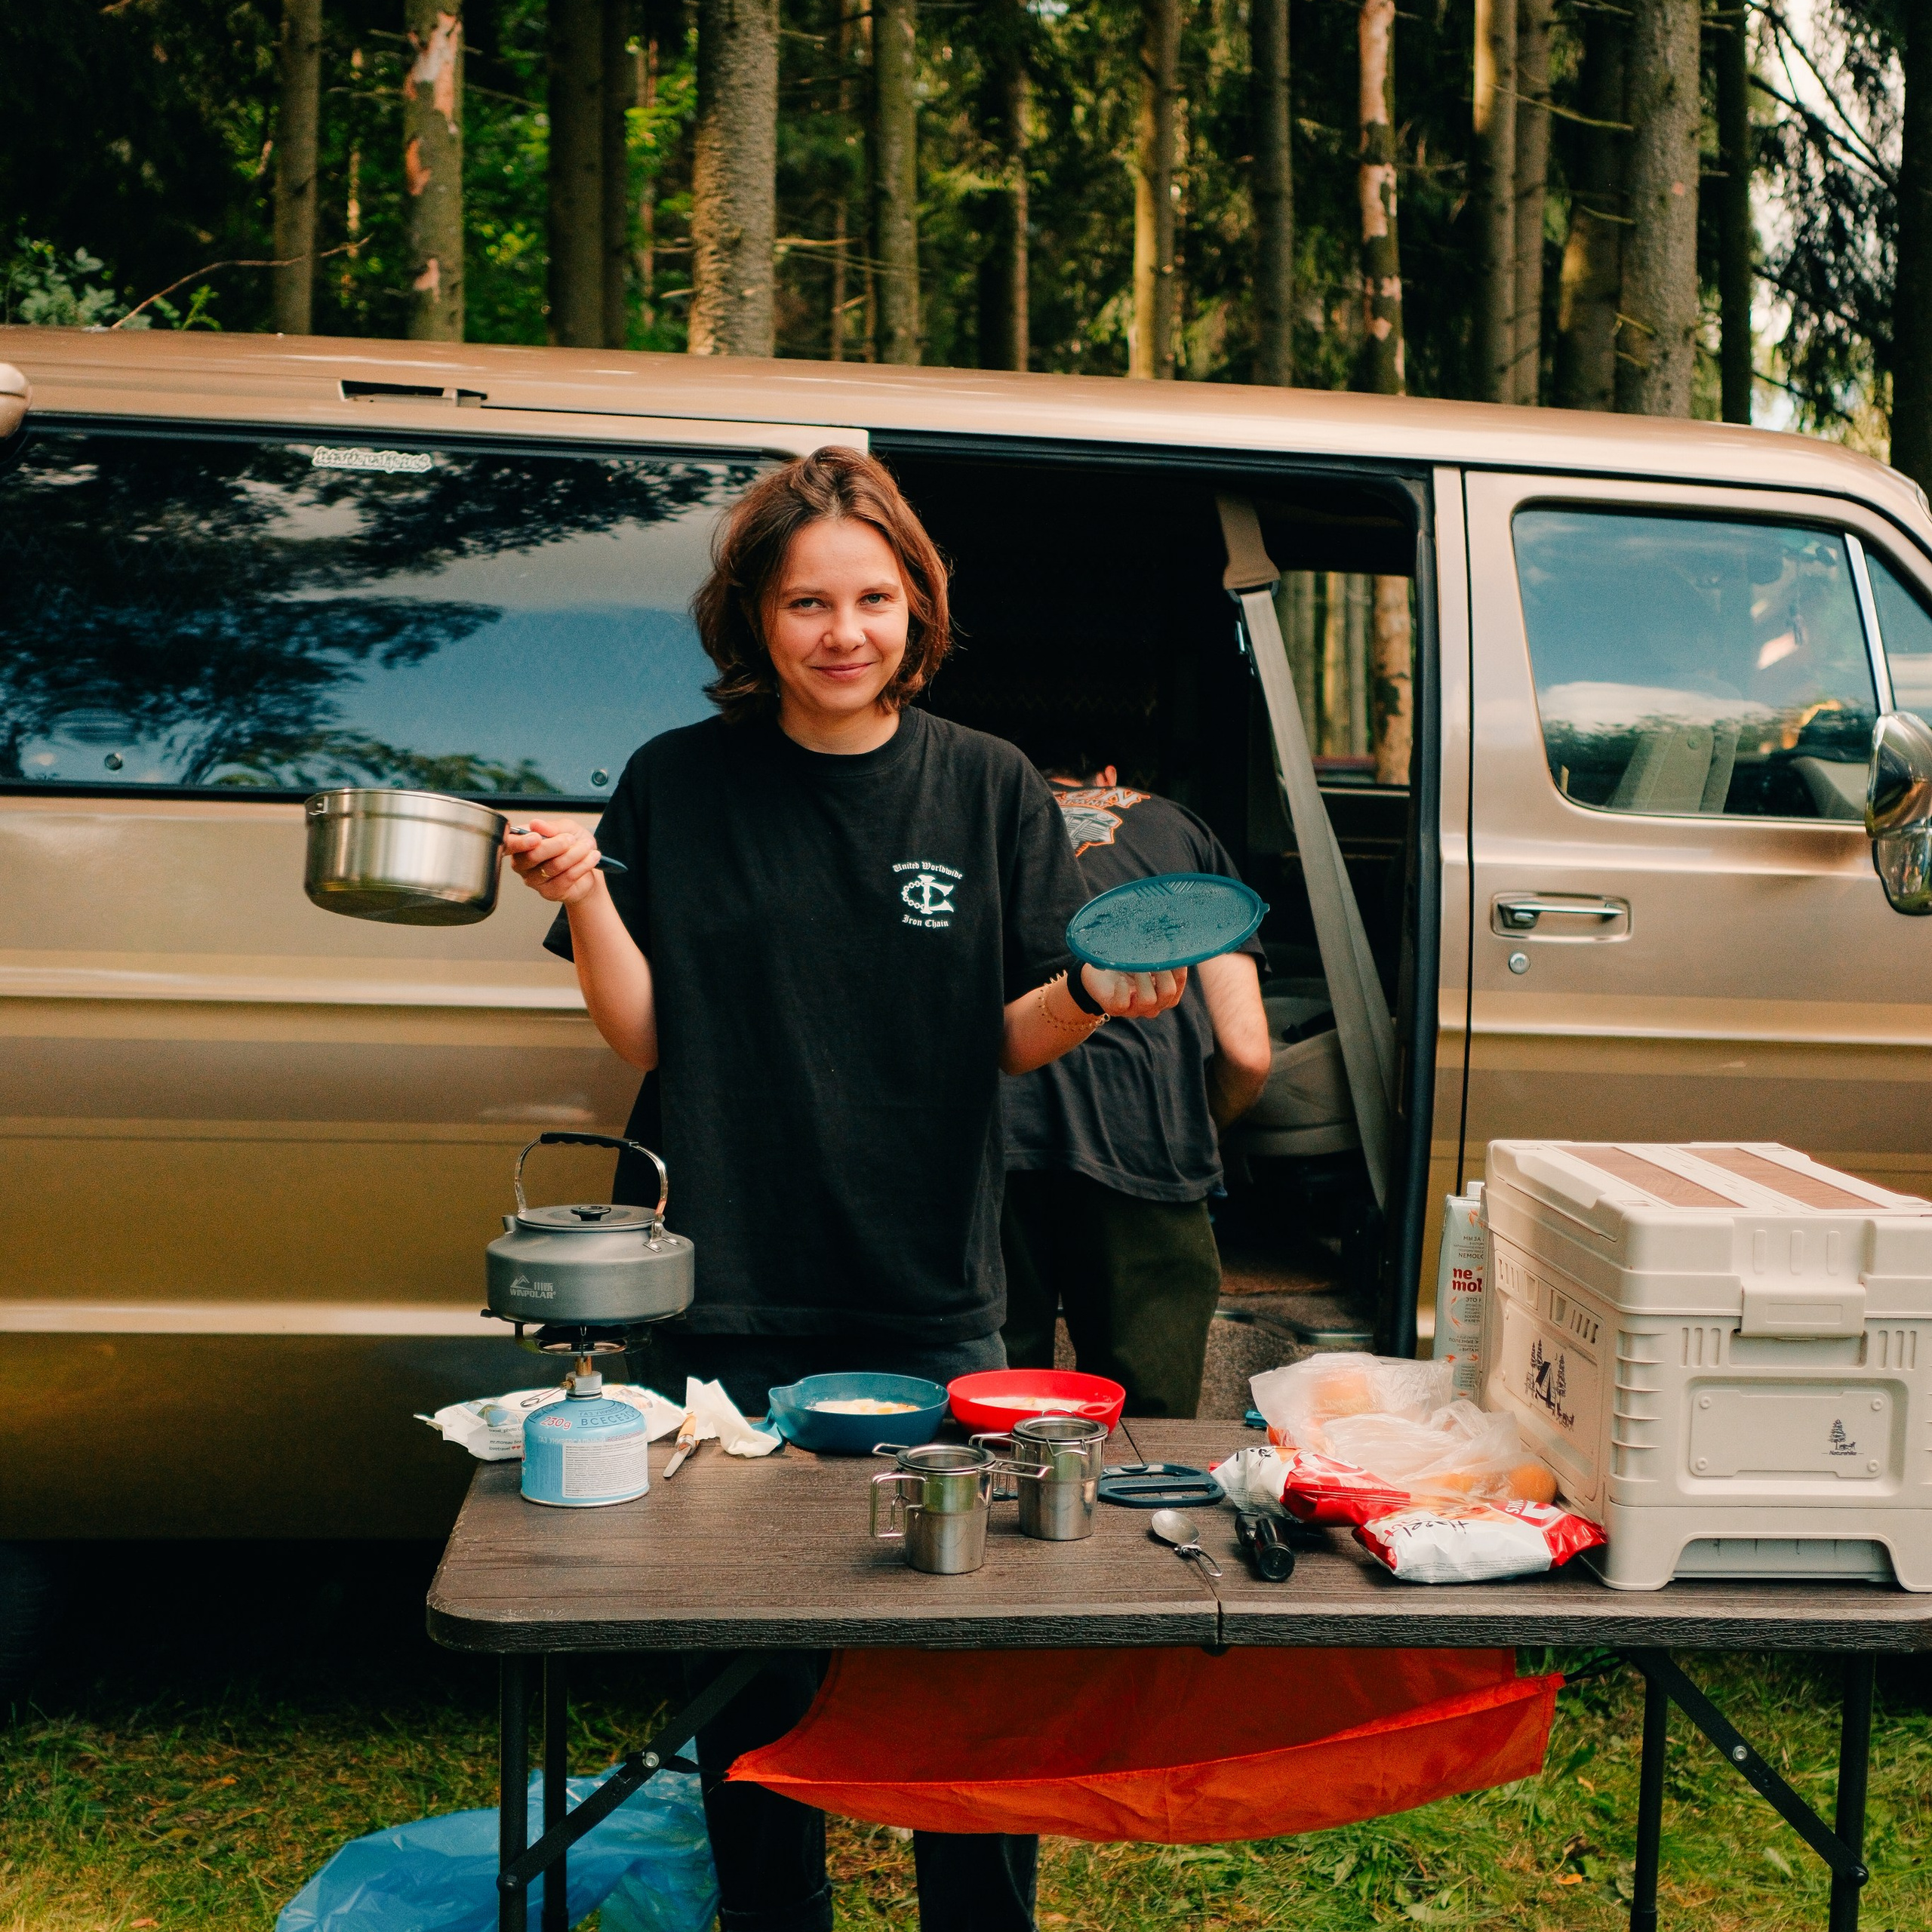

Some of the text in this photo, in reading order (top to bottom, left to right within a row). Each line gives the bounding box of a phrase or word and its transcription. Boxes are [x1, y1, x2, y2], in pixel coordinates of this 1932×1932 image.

[892, 862, 963, 879] United Worldwide
[902, 915, 949, 928] Iron Chain
[1453, 1268, 1472, 1279] ne
